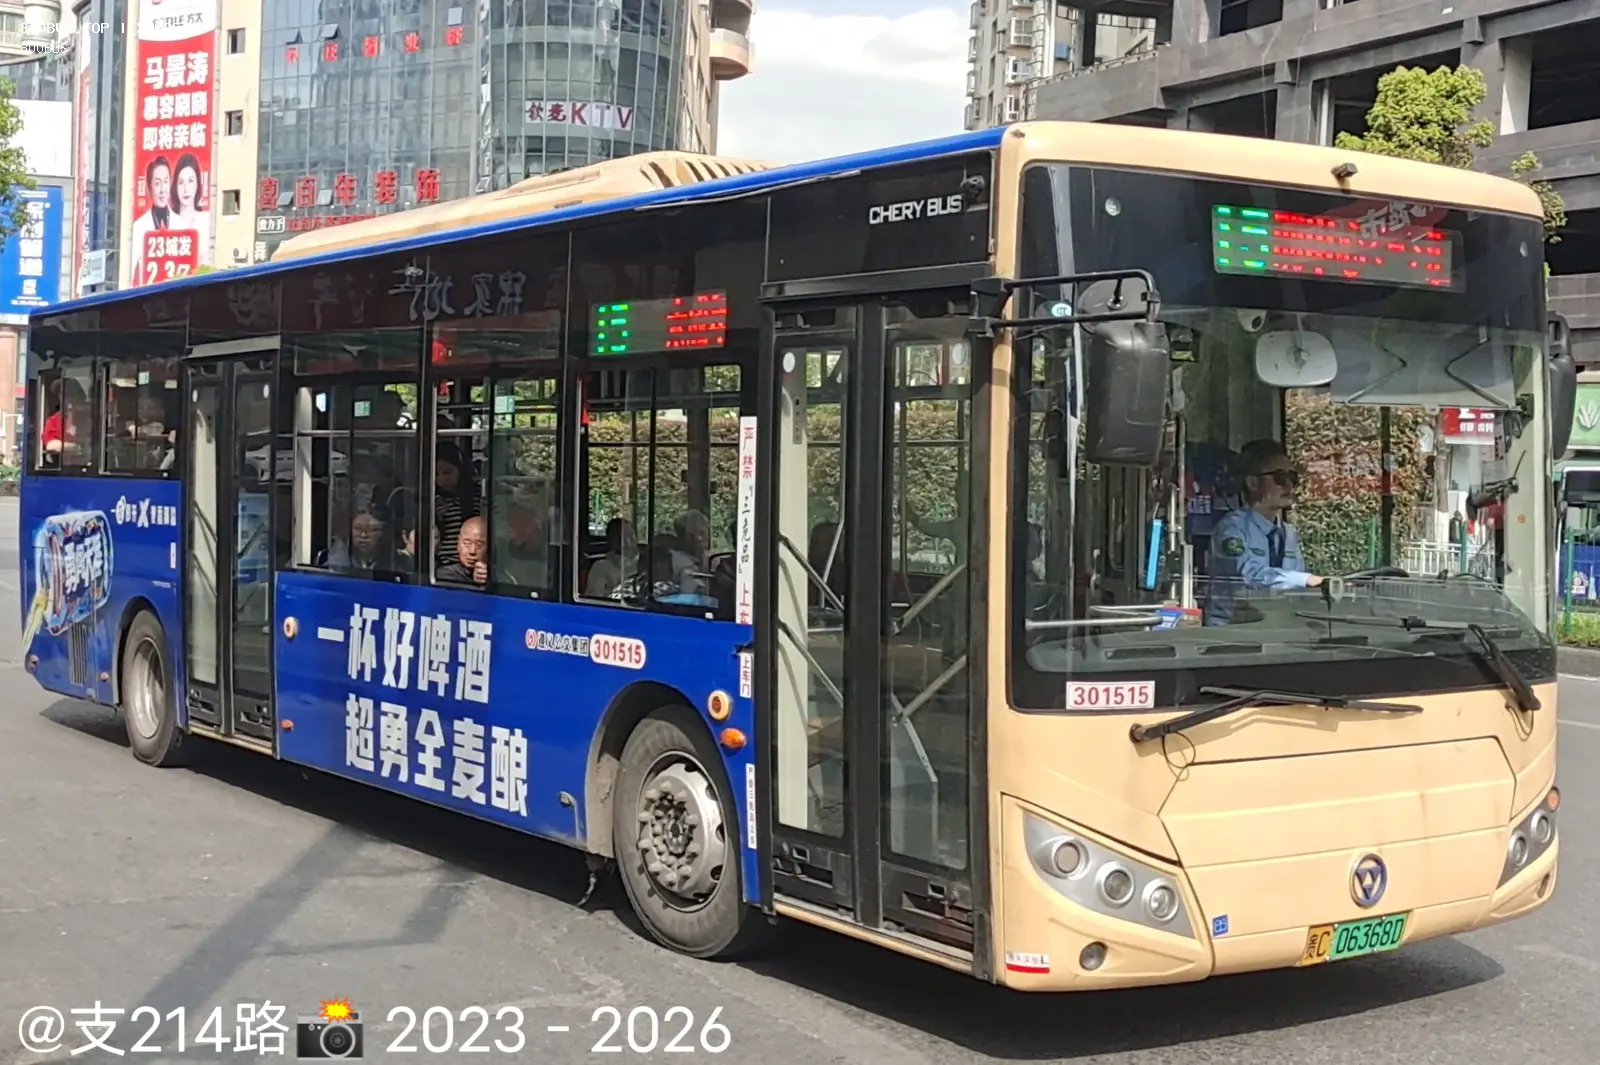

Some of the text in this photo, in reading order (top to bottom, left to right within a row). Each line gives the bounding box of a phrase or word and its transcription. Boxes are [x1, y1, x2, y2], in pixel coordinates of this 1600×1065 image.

[144, 51, 209, 90] 马景涛
[142, 122, 206, 151] 即将亲临
[869, 194, 962, 225] CHERY BUS
[317, 603, 493, 704] 一杯好啤酒
[593, 639, 643, 665] 301515
[1073, 685, 1150, 706] 301515
[345, 692, 528, 817] 超勇全麦酿
